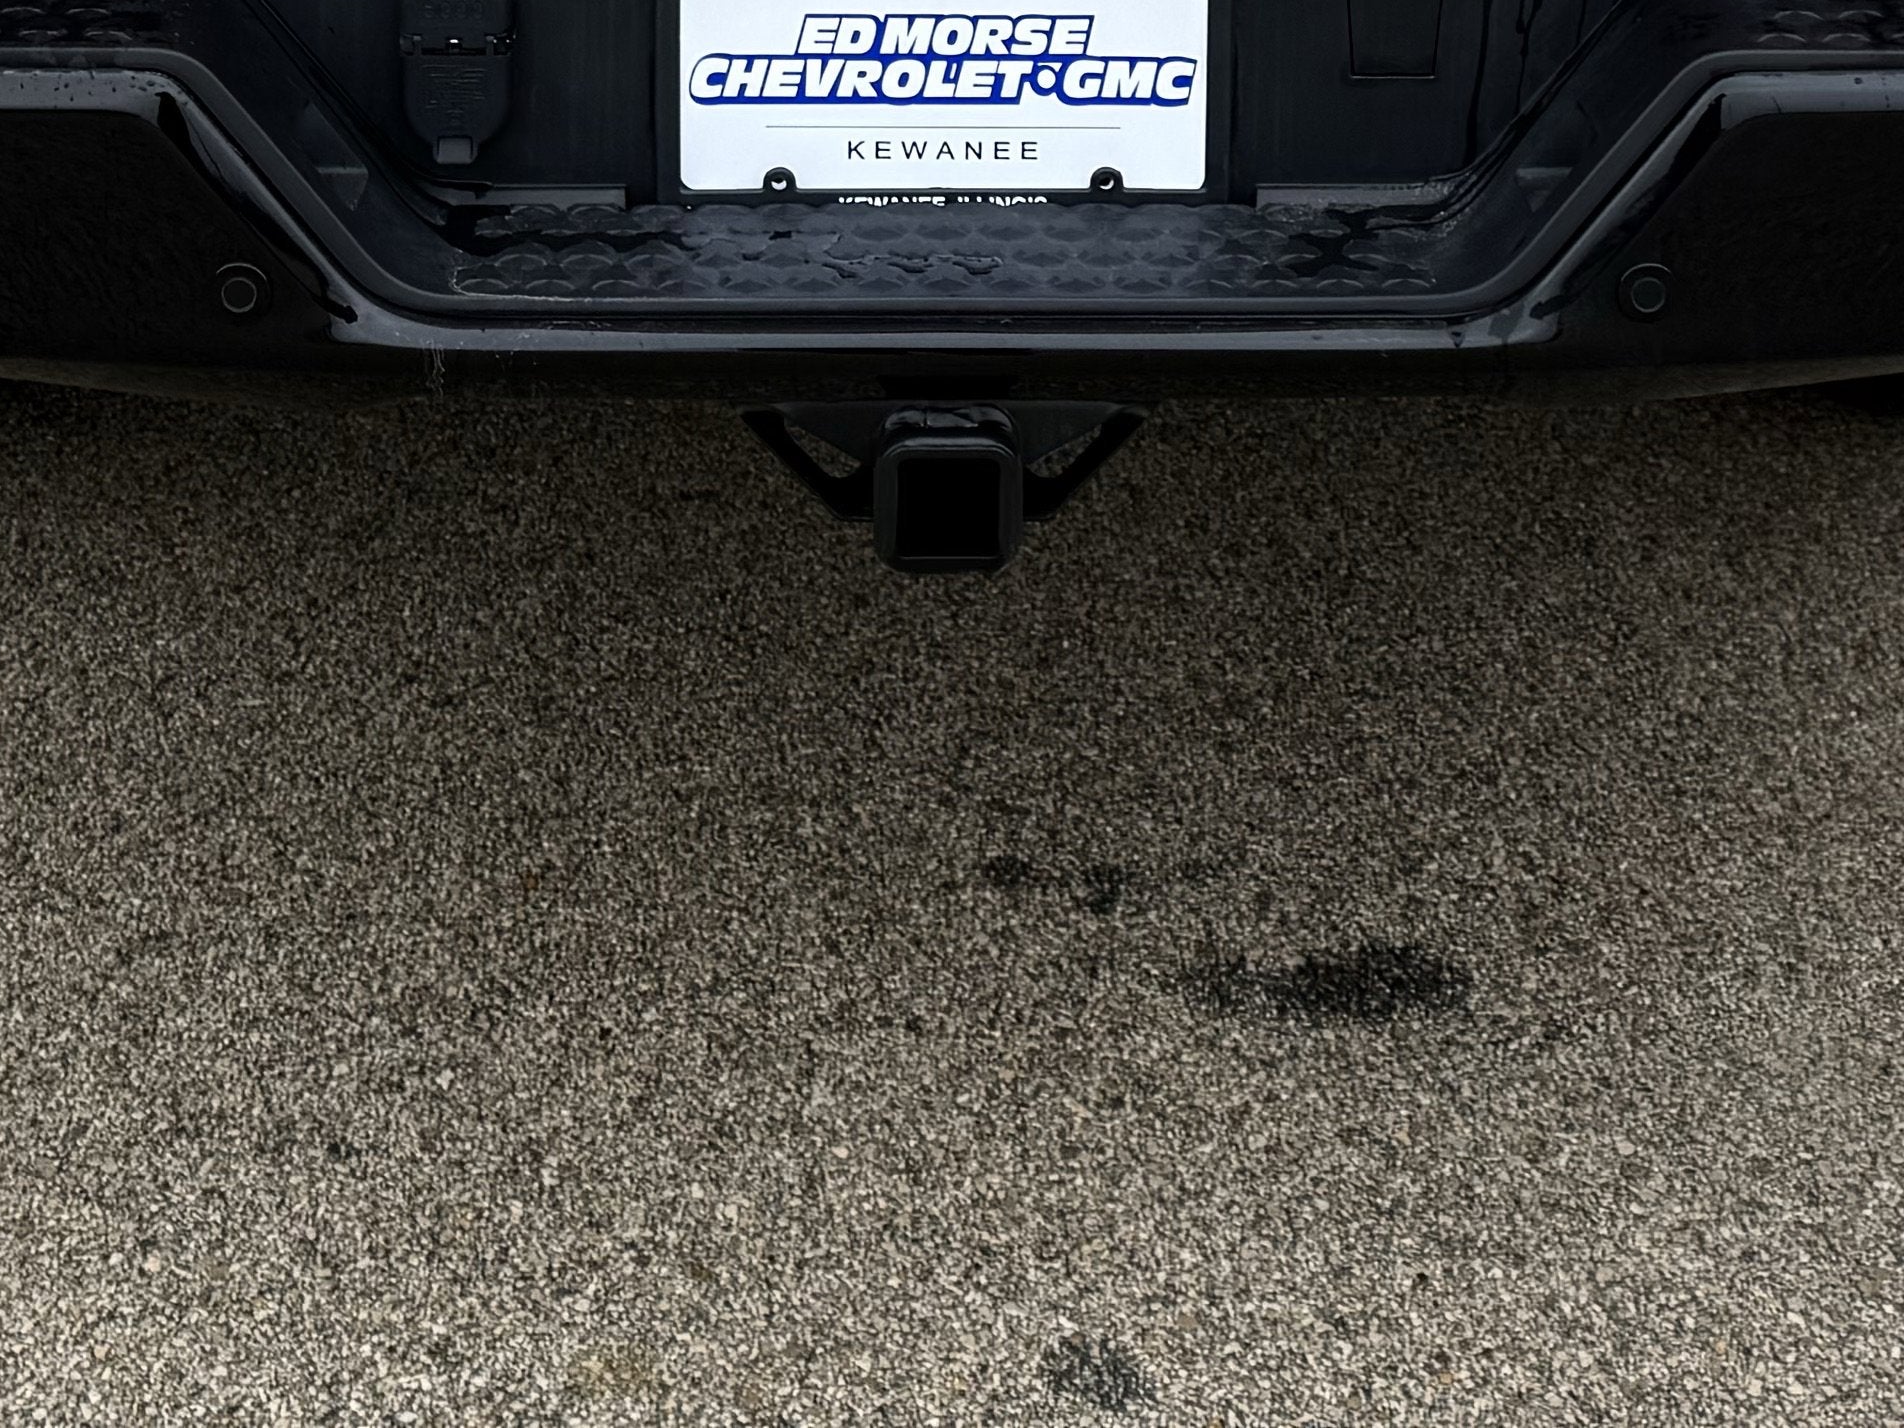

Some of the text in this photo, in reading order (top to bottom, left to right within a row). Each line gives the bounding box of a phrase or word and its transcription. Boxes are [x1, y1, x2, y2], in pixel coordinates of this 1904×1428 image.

[796, 15, 1093, 55] ED MORSE
[847, 140, 1039, 161] KEWANEE
